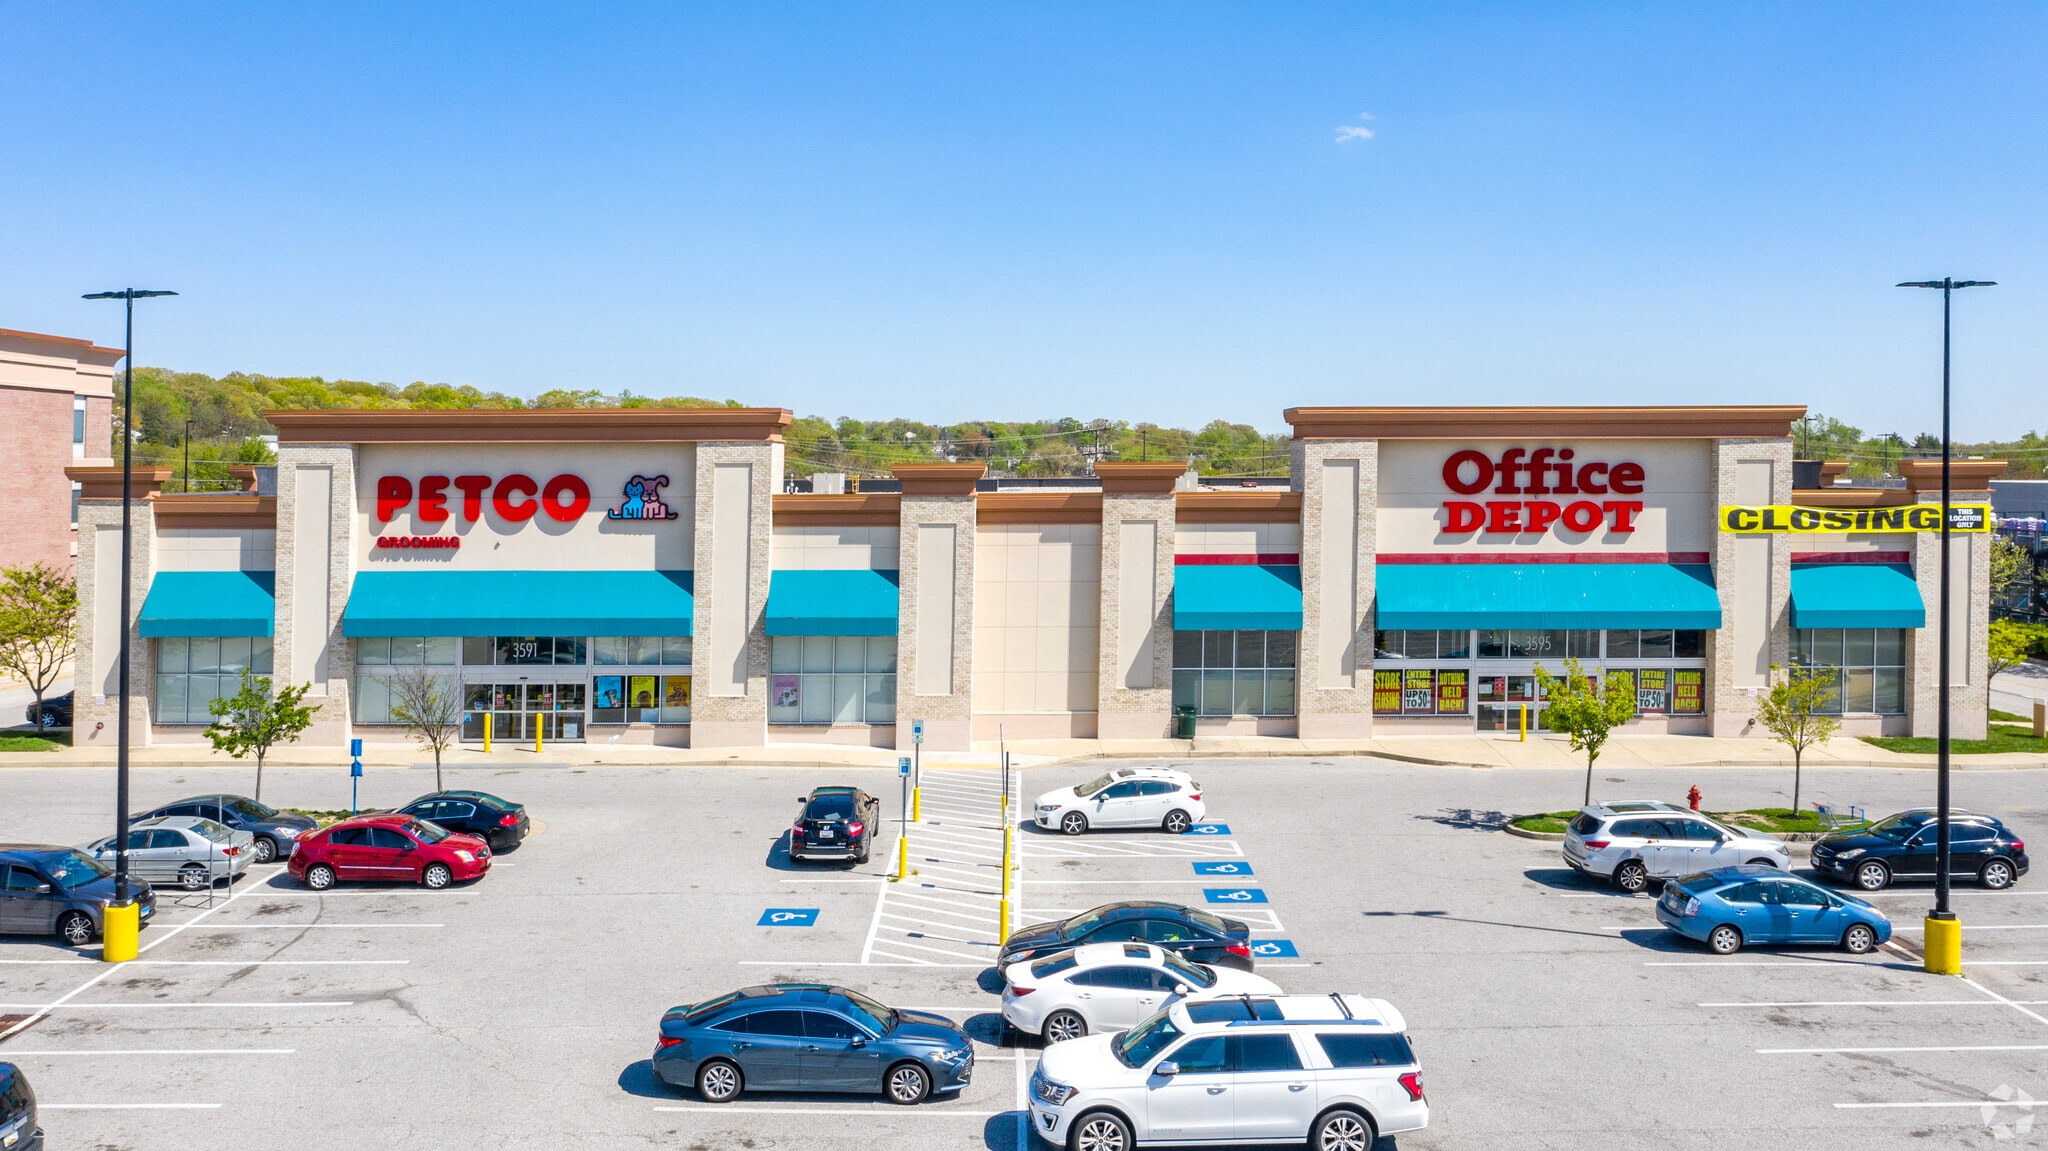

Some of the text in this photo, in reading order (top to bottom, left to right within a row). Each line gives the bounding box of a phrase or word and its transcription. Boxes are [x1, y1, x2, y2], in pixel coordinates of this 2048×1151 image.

[1442, 448, 1645, 495] Office
[376, 473, 591, 522] PETCO
[1442, 501, 1643, 533] DEPOT
[1727, 508, 1940, 530] CLOSING
[376, 536, 460, 549] GROOMING
[1525, 636, 1551, 650] 3595
[512, 642, 537, 658] 3591
[1375, 672, 1400, 689] STORE
[1439, 672, 1465, 685] NOTHING
[1641, 670, 1666, 679] ENTIRE
[1675, 671, 1701, 684] NOTHING
[1407, 679, 1431, 689] STORE
[1641, 679, 1665, 689] STORE
[1406, 690, 1418, 699] UP
[1442, 686, 1461, 698] HELD
[1640, 690, 1651, 698] UP
[1677, 685, 1697, 697] HELD
[1375, 692, 1399, 710] CLOSING
[1406, 699, 1418, 707] TO
[1439, 699, 1464, 711] BACK!
[1639, 699, 1650, 707] TO
[1675, 698, 1701, 710] BACK!
